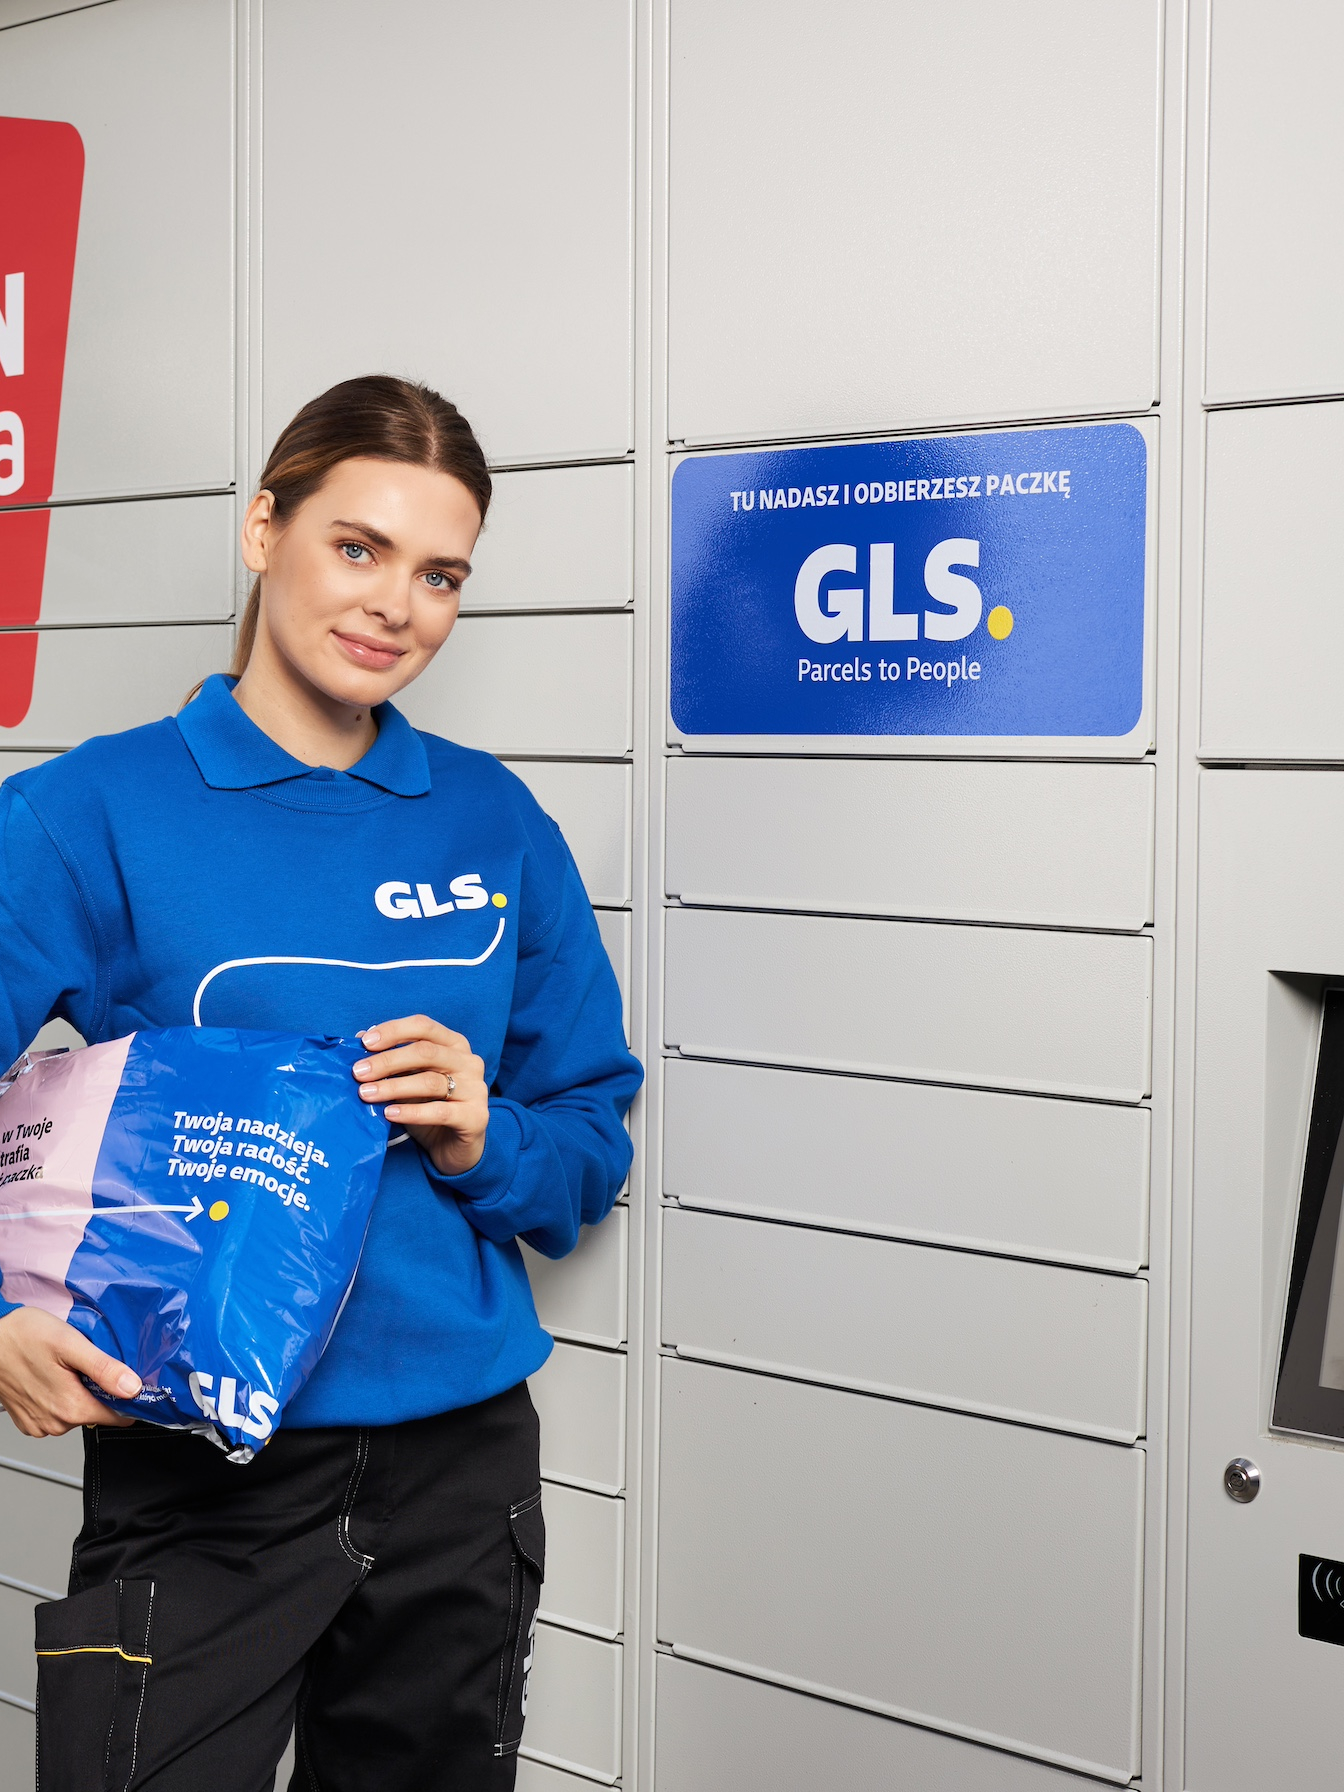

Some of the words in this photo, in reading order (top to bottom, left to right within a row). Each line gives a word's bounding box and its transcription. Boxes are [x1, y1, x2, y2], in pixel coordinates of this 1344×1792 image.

[730, 491, 754, 511] TU
[760, 485, 838, 509] NADASZ
[844, 484, 849, 504] I
[855, 476, 980, 504] ODBIERZESZ
[986, 470, 1071, 498] PACZKĘ
[798, 657, 872, 682] Parcels
[878, 658, 900, 680] to
[906, 655, 981, 687] People
[2, 1130, 14, 1144] w
[16, 1117, 53, 1140] Twoje
[173, 1111, 233, 1136] Twoja
[236, 1117, 330, 1168] nadzieja.
[0, 1144, 29, 1167] trafia
[173, 1135, 233, 1159] Twoja
[236, 1142, 311, 1185] radość.
[168, 1158, 227, 1182] Twoje
[230, 1166, 310, 1212] emocje.
